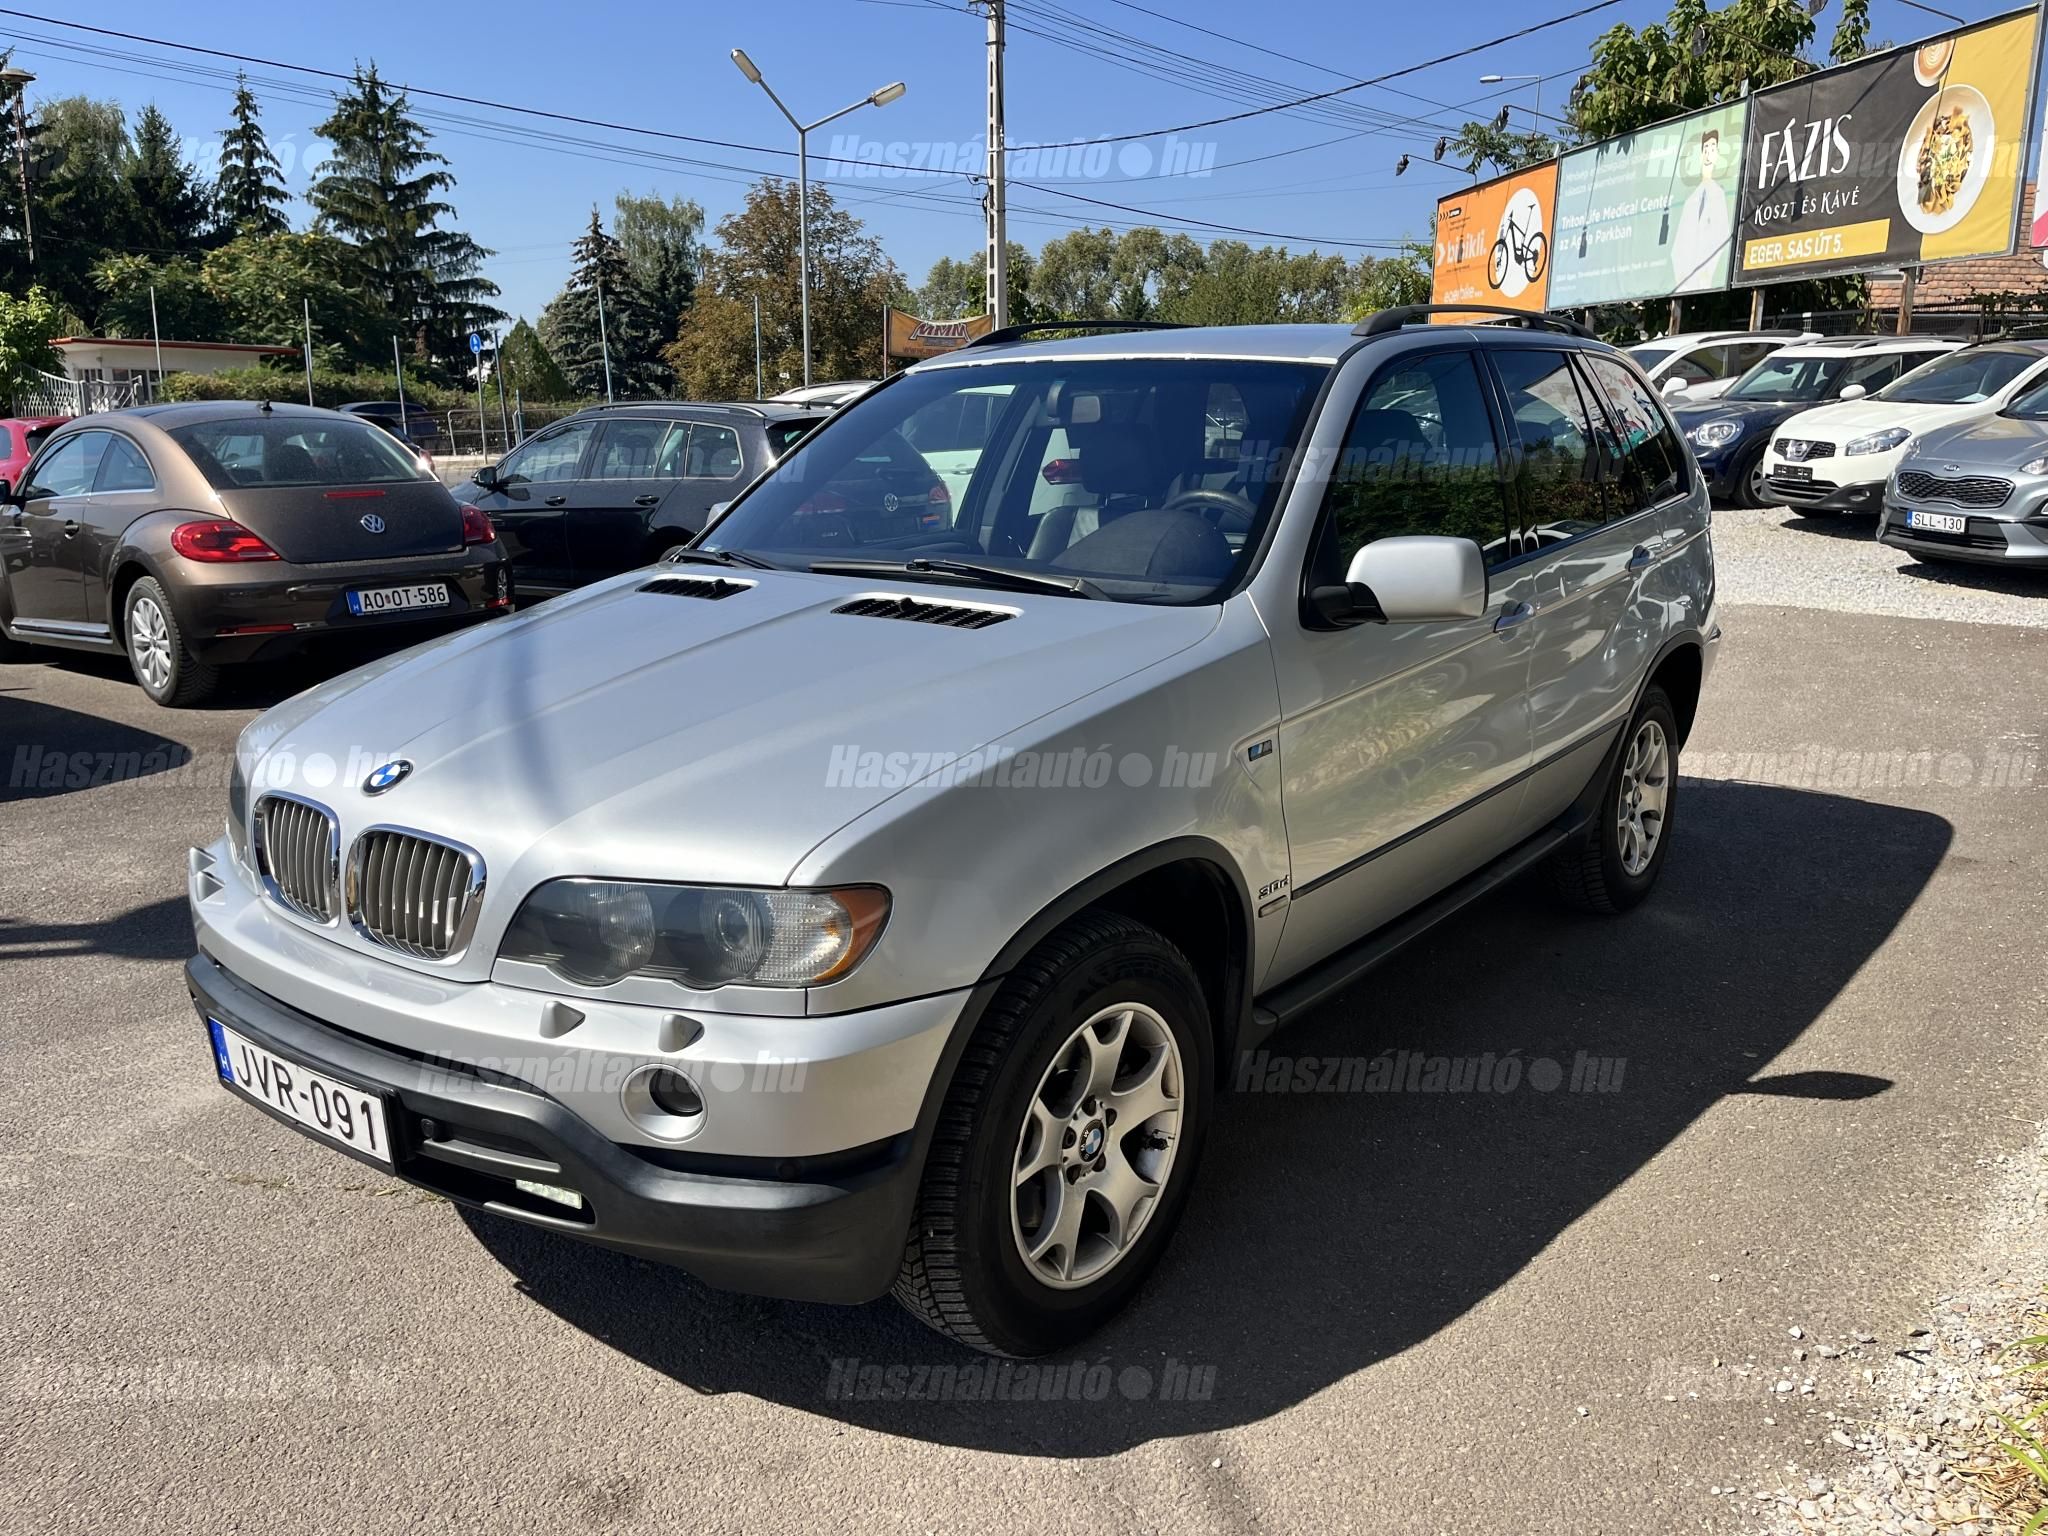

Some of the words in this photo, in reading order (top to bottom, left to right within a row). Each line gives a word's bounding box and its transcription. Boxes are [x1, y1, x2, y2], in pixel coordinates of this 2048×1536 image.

[1758, 114, 1852, 189] FÁZIS
[1603, 199, 1639, 219] Medical
[1641, 194, 1675, 212] Center
[1754, 202, 1796, 226] KOSZT
[1801, 196, 1817, 214] ÉS
[1821, 186, 1860, 214] KÁVÉ
[1570, 233, 1593, 250] Agia
[1595, 225, 1633, 243] Parkban
[1749, 242, 1784, 265] EGER,
[1787, 238, 1813, 259] SAS
[1814, 231, 1833, 255] ÚT
[1833, 233, 1844, 254] 5.
[908, 322, 973, 343] MMM
[1914, 513, 1962, 531] SLL-130
[234, 1043, 377, 1151] JVR-091
